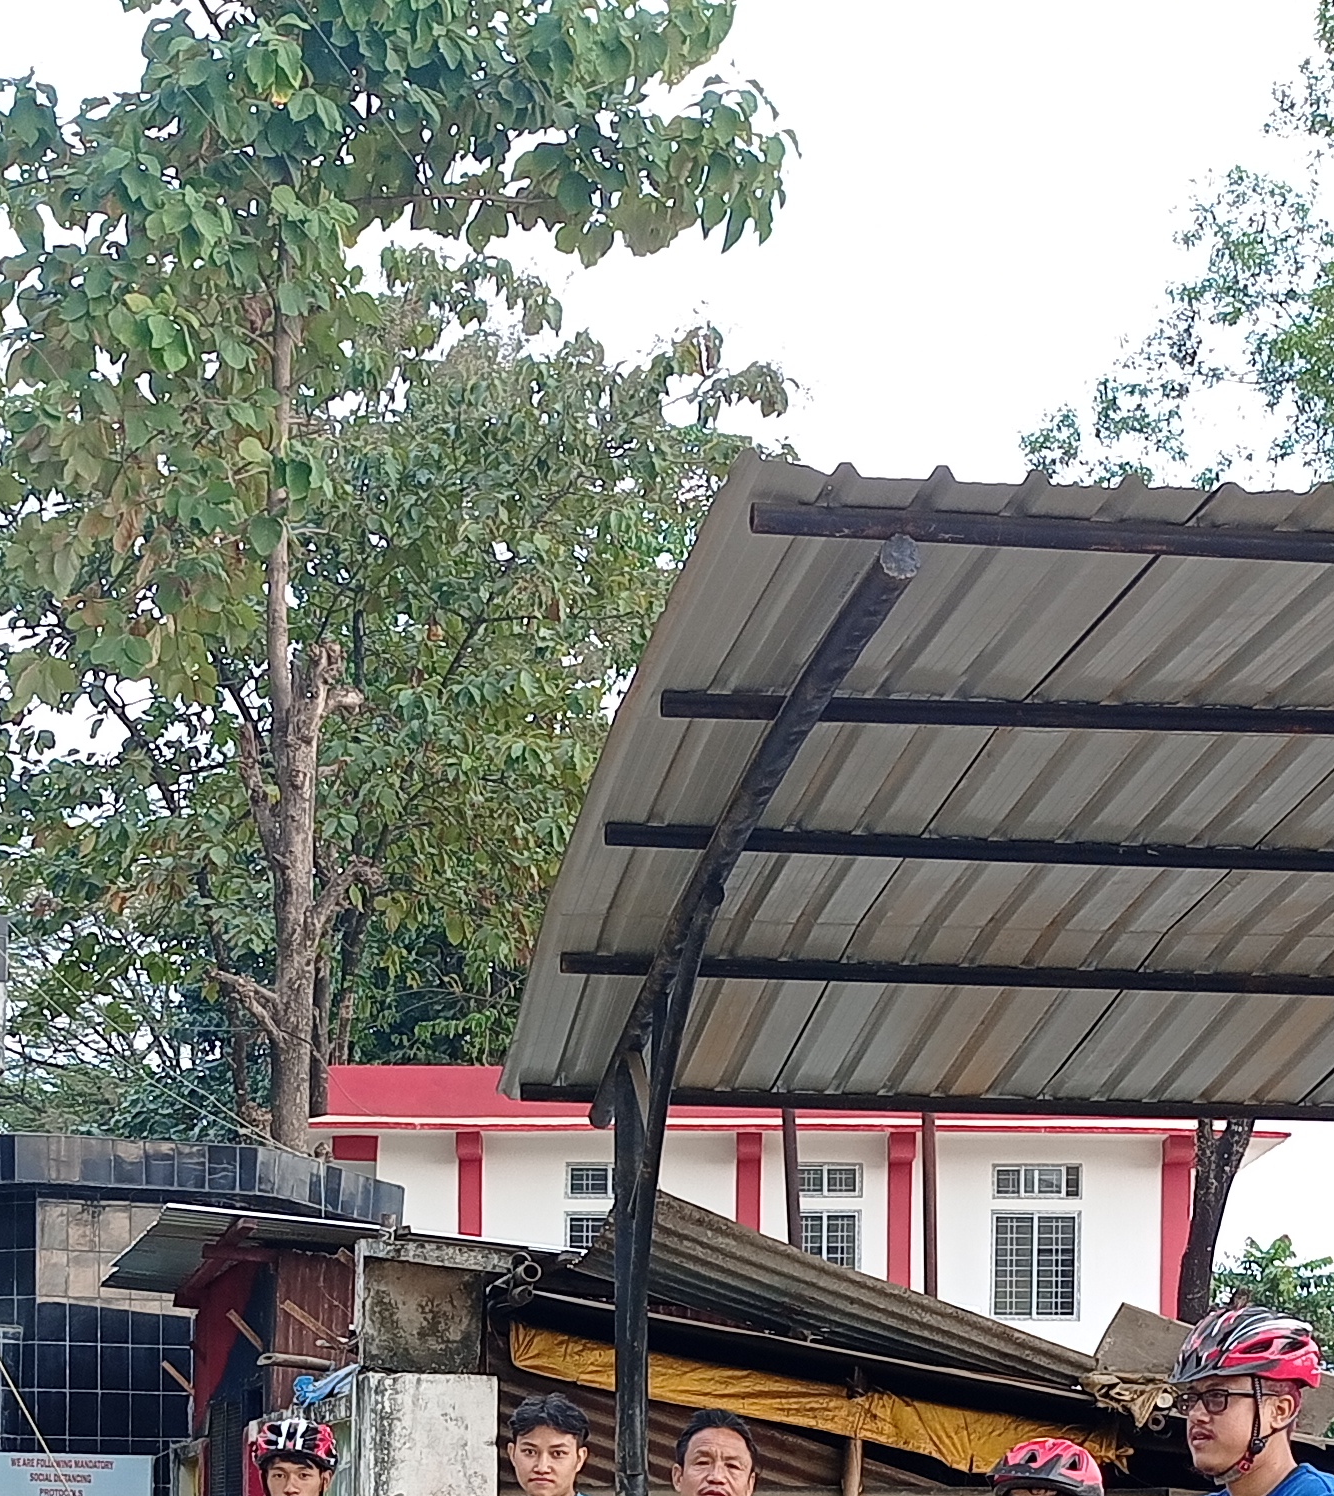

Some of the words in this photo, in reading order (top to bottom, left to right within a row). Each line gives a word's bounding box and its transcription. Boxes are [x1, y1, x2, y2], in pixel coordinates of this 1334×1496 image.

[11, 1457, 22, 1467] WE
[22, 1458, 35, 1468] ARE
[74, 1459, 115, 1470] MANDATORY
[29, 1472, 53, 1483] SOCIAL
